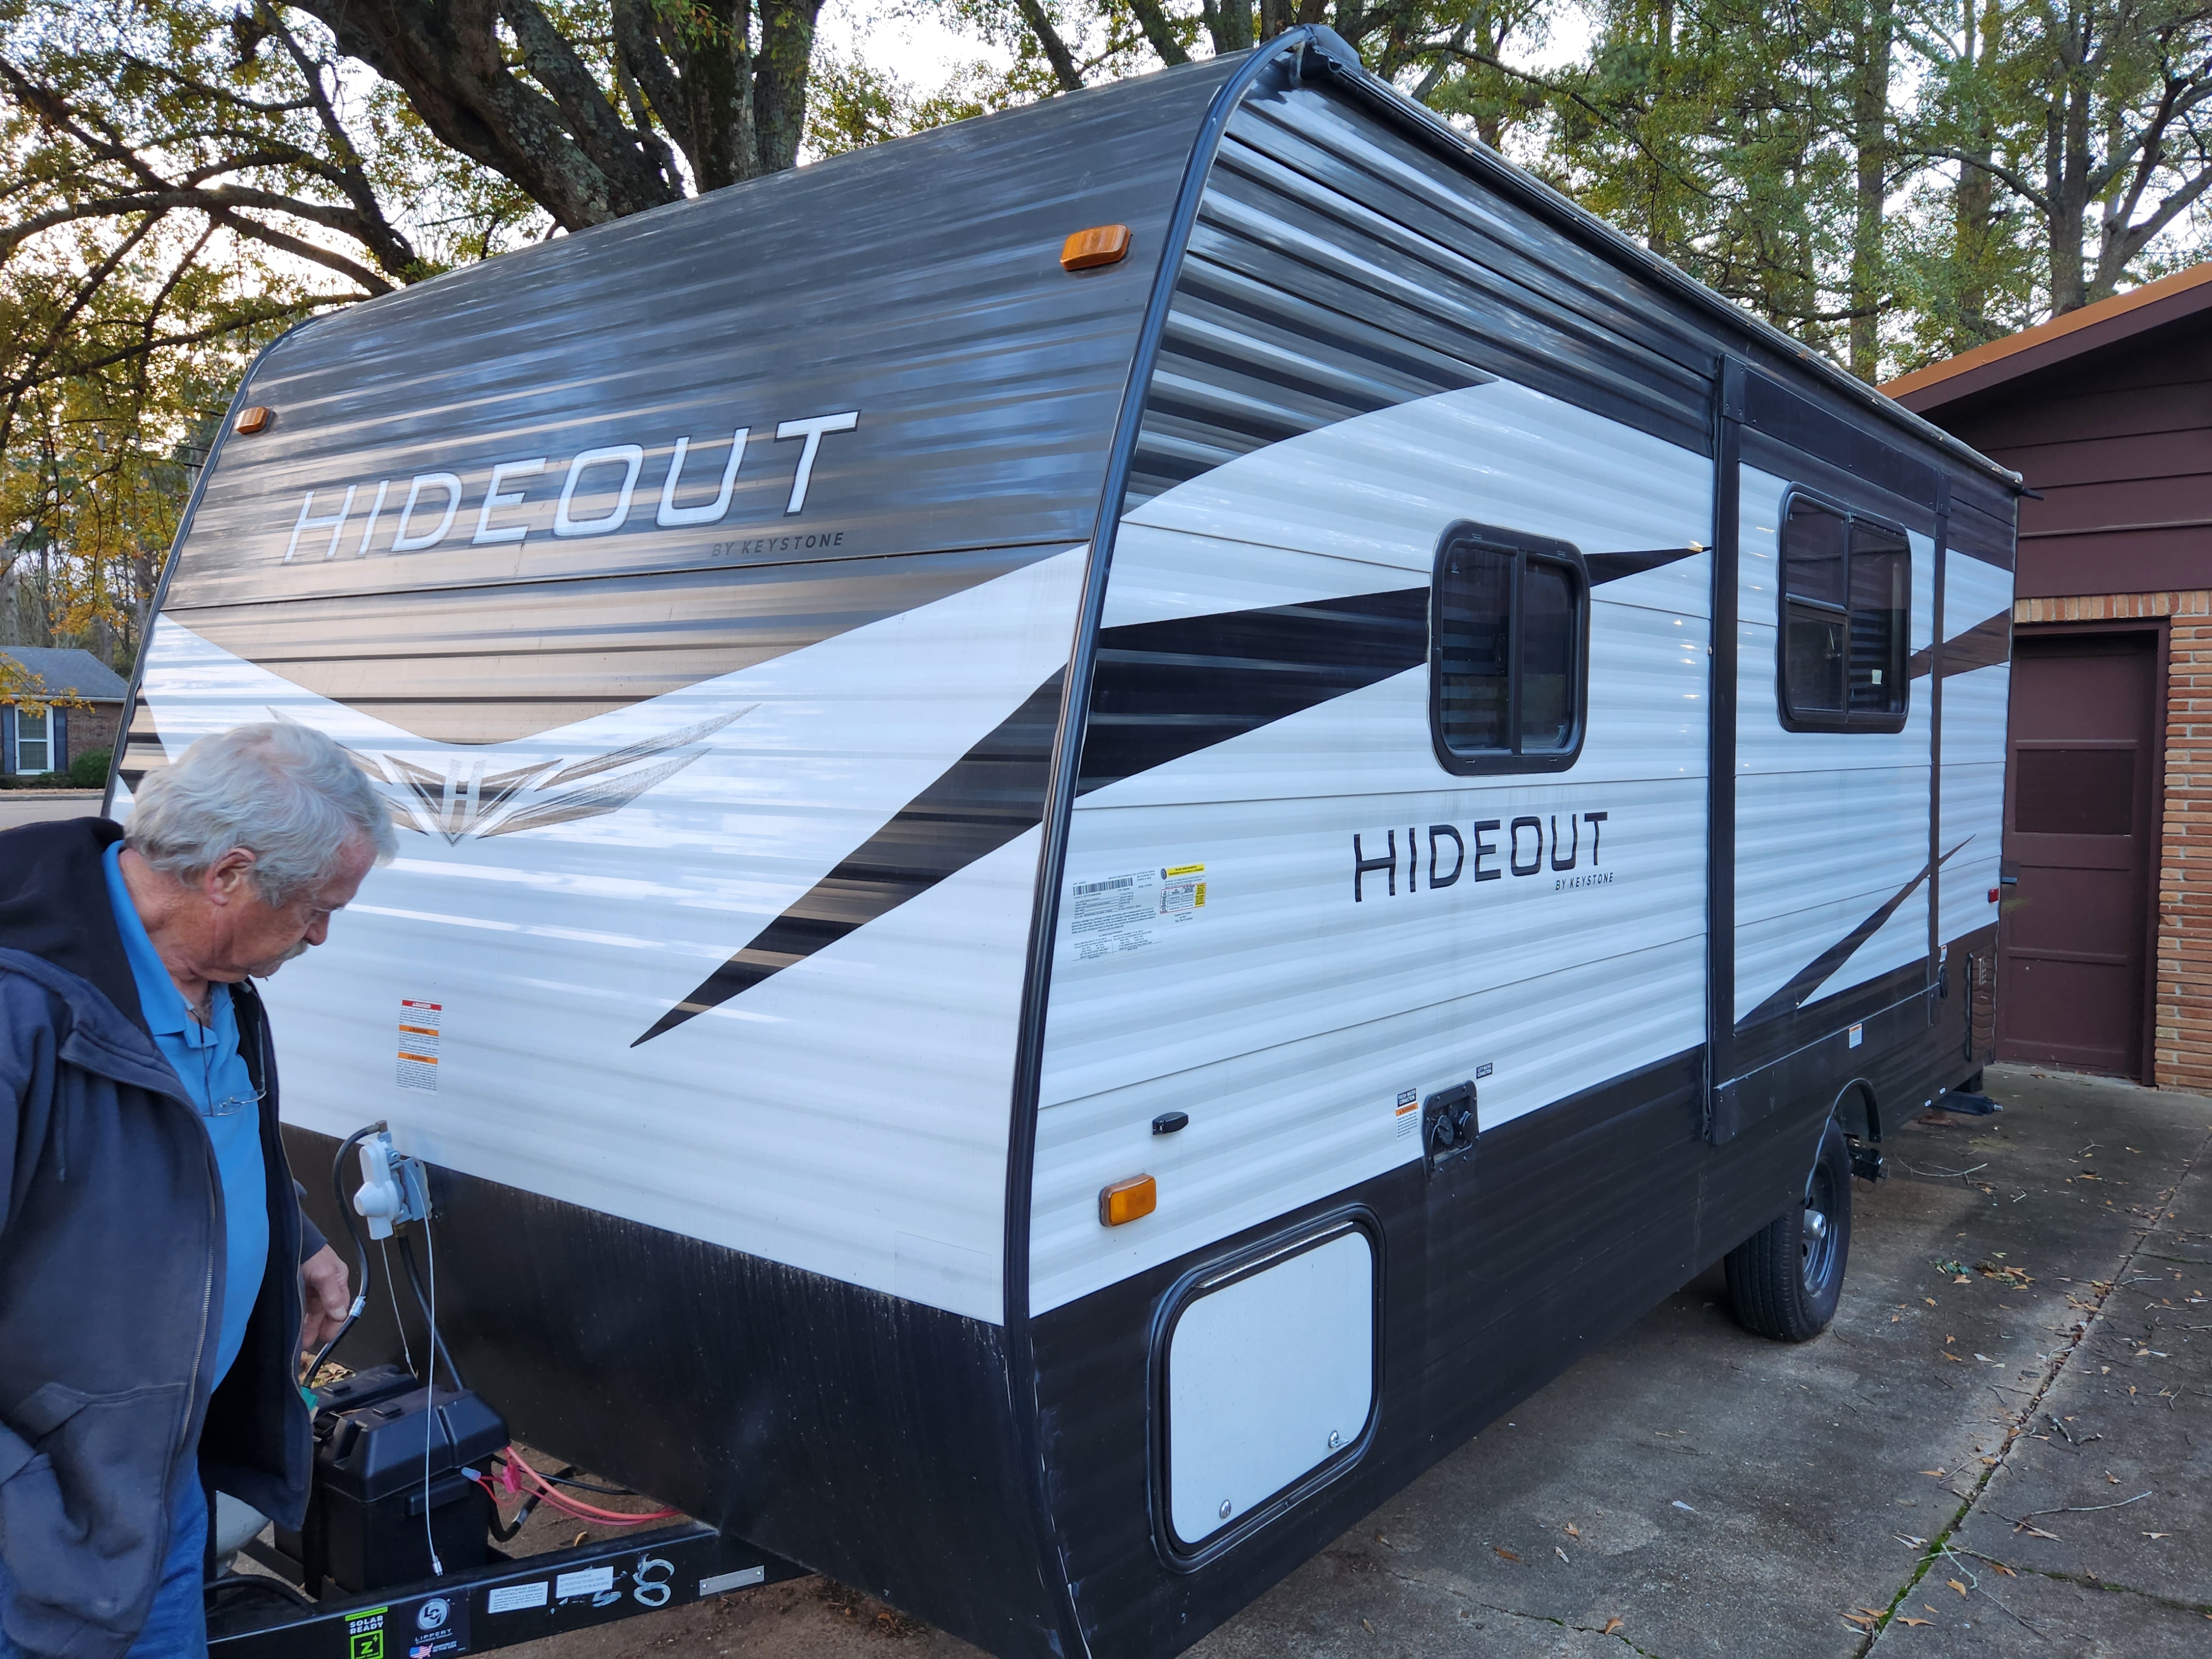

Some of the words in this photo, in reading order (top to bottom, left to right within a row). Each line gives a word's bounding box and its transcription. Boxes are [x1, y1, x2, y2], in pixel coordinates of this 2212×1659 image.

[281, 409, 860, 565] HIDEOUT
[712, 541, 734, 557] BY
[741, 533, 844, 555] KEYSTONE
[1354, 812, 1608, 902] HIDEOUT
[1556, 879, 1566, 890] BY
[1569, 872, 1614, 889] KEYSTONE
[349, 1615, 383, 1628] SOLAR
[349, 1621, 383, 1635] READY
[415, 1628, 452, 1641] LIPPERT
[361, 1641, 373, 1655] Z
